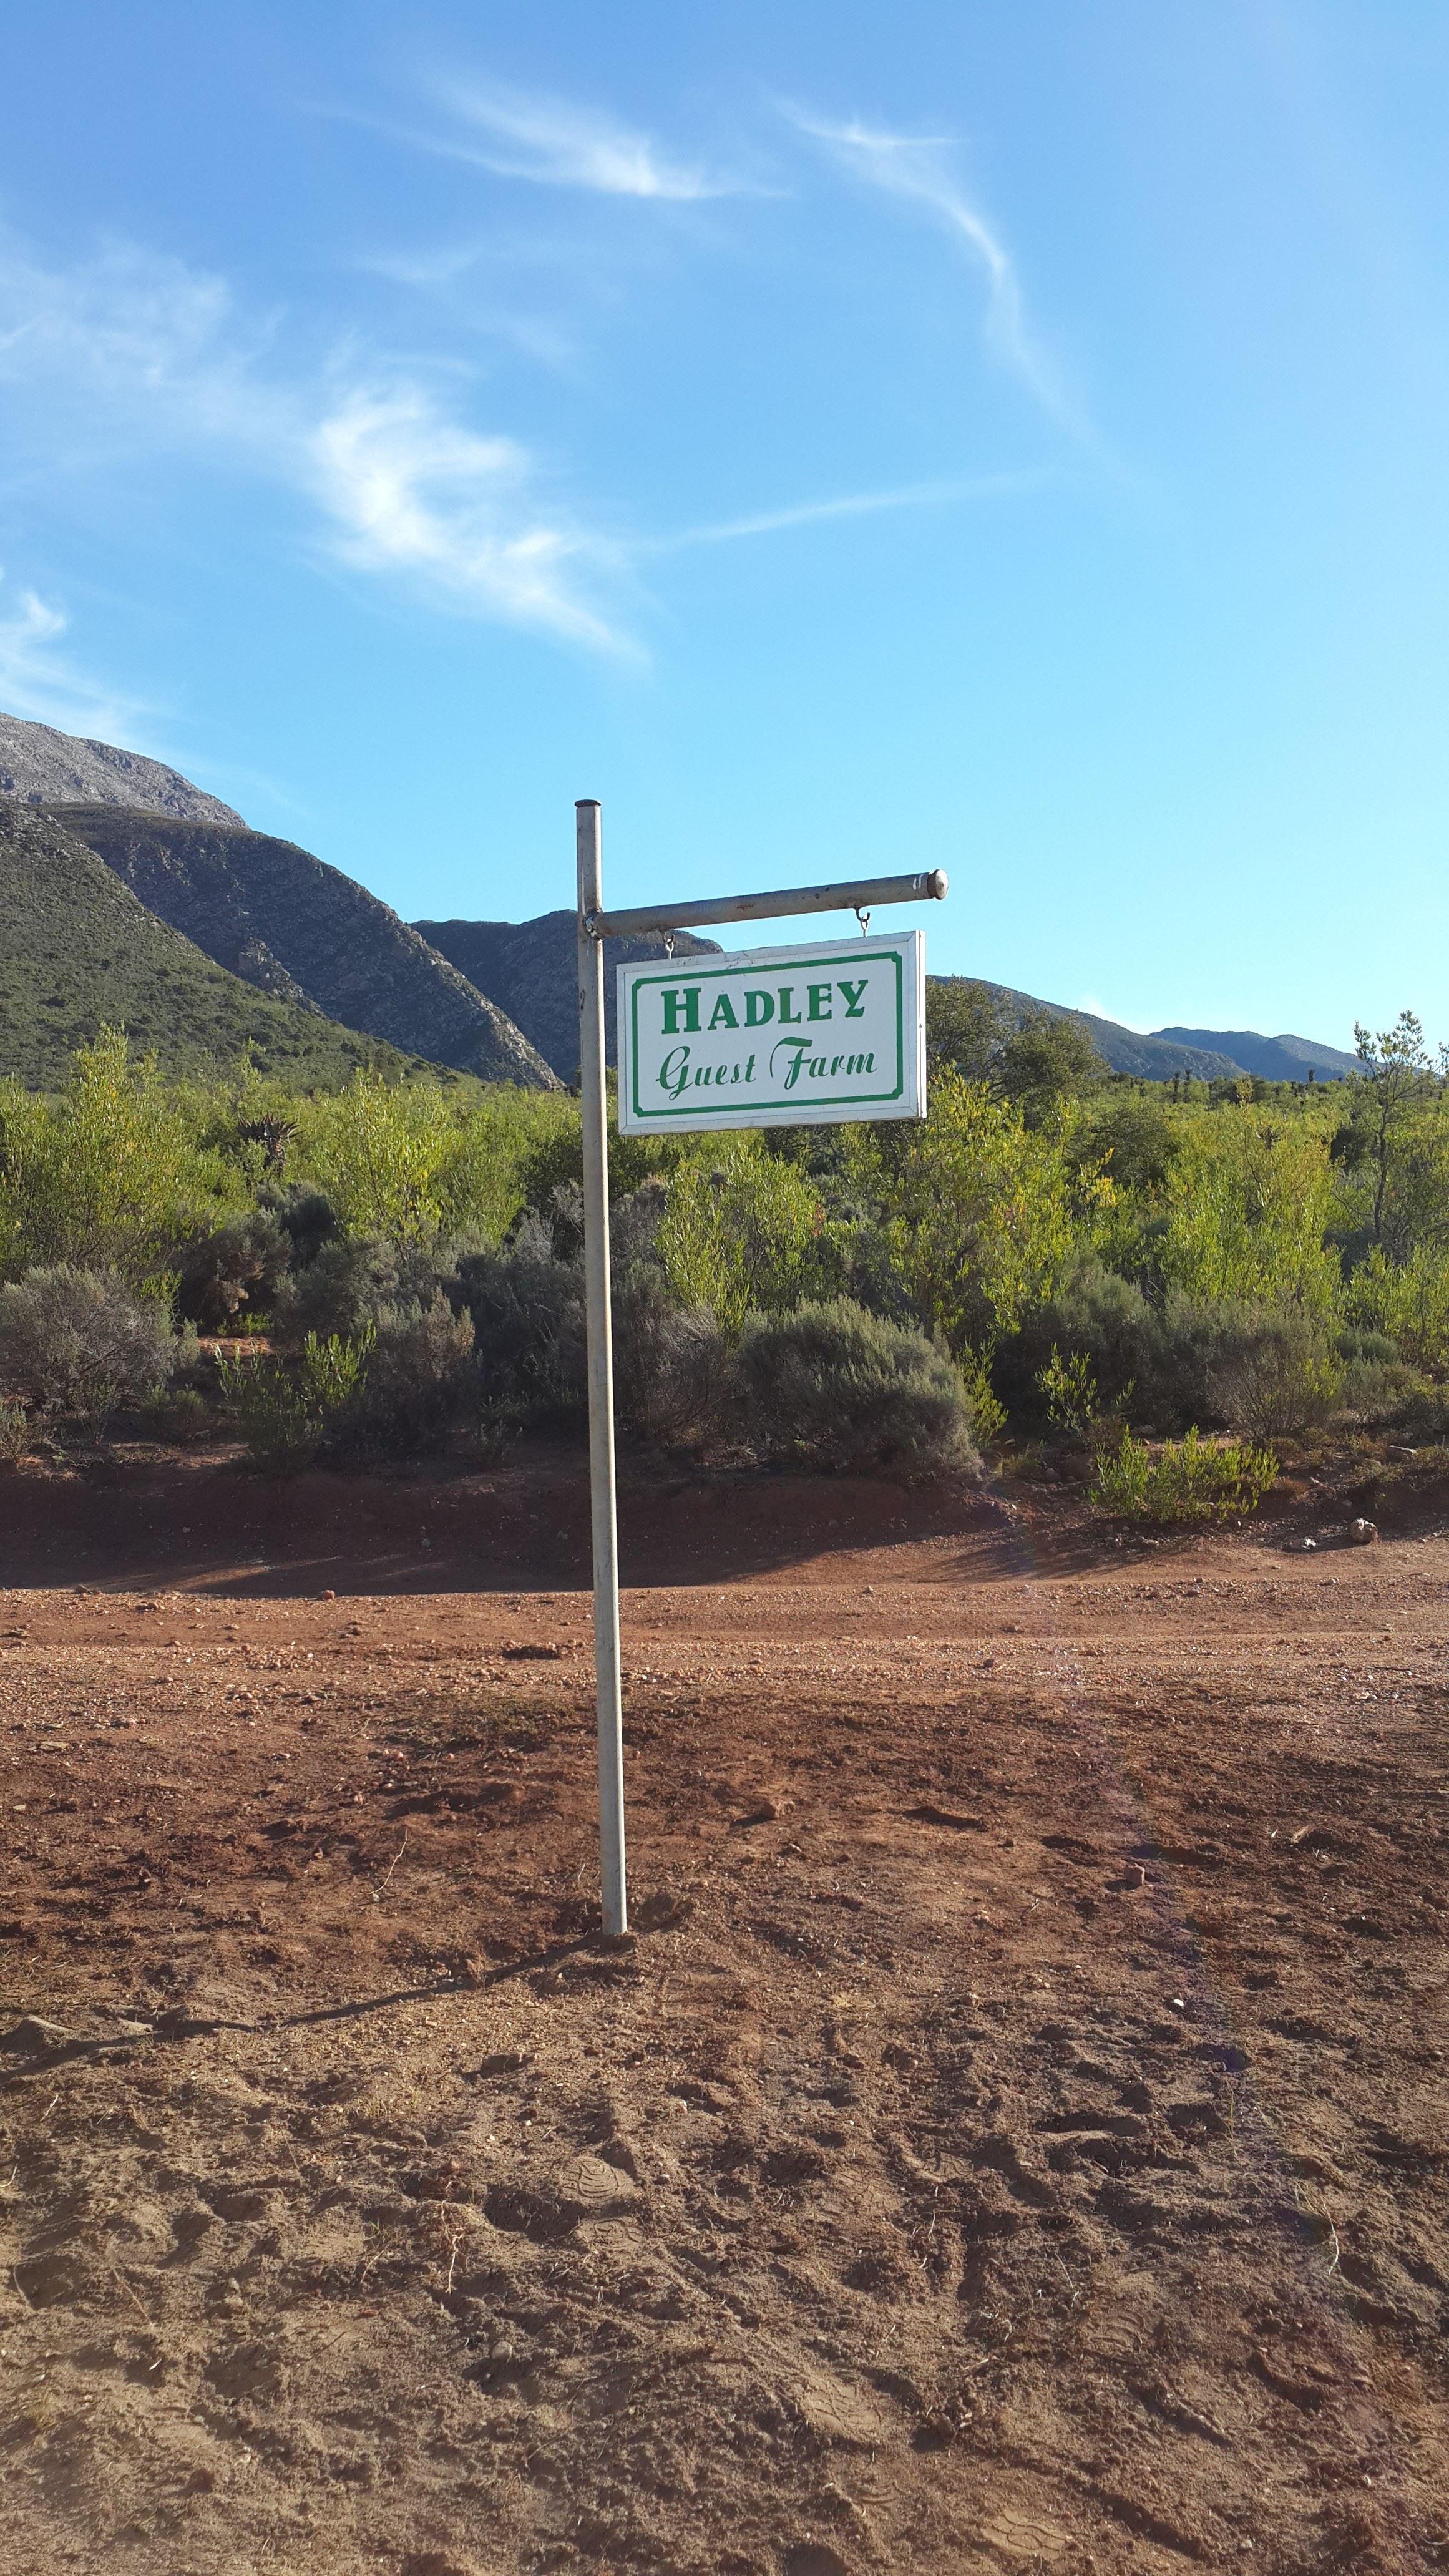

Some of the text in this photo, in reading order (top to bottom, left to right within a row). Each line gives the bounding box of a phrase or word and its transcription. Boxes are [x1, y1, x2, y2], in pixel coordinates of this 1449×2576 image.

[661, 980, 869, 1035] HADLEY
[656, 1037, 877, 1101] Guest Farm
